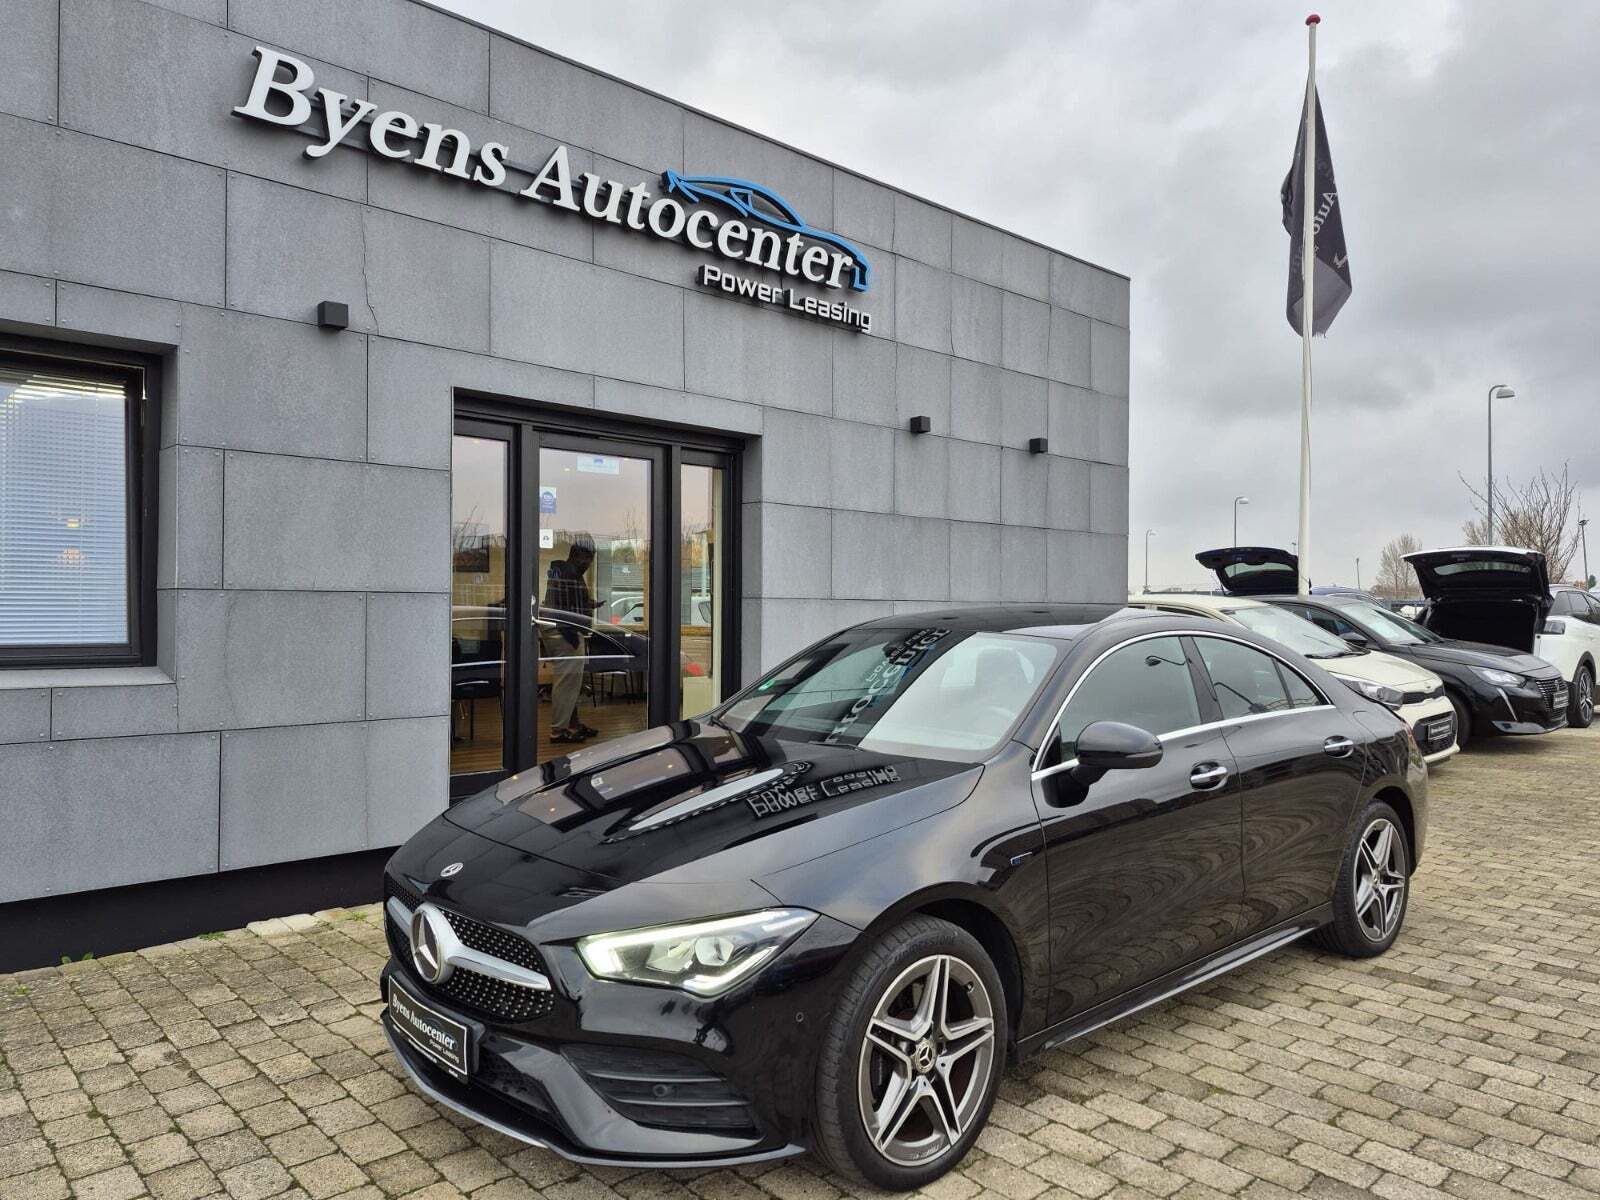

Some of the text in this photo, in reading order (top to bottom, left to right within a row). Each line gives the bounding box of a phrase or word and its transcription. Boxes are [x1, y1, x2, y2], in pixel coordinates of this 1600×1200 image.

[233, 46, 853, 288] Byens Autocenter
[703, 263, 872, 333] Power Leasing
[392, 993, 455, 1050] Byens Autocenter
